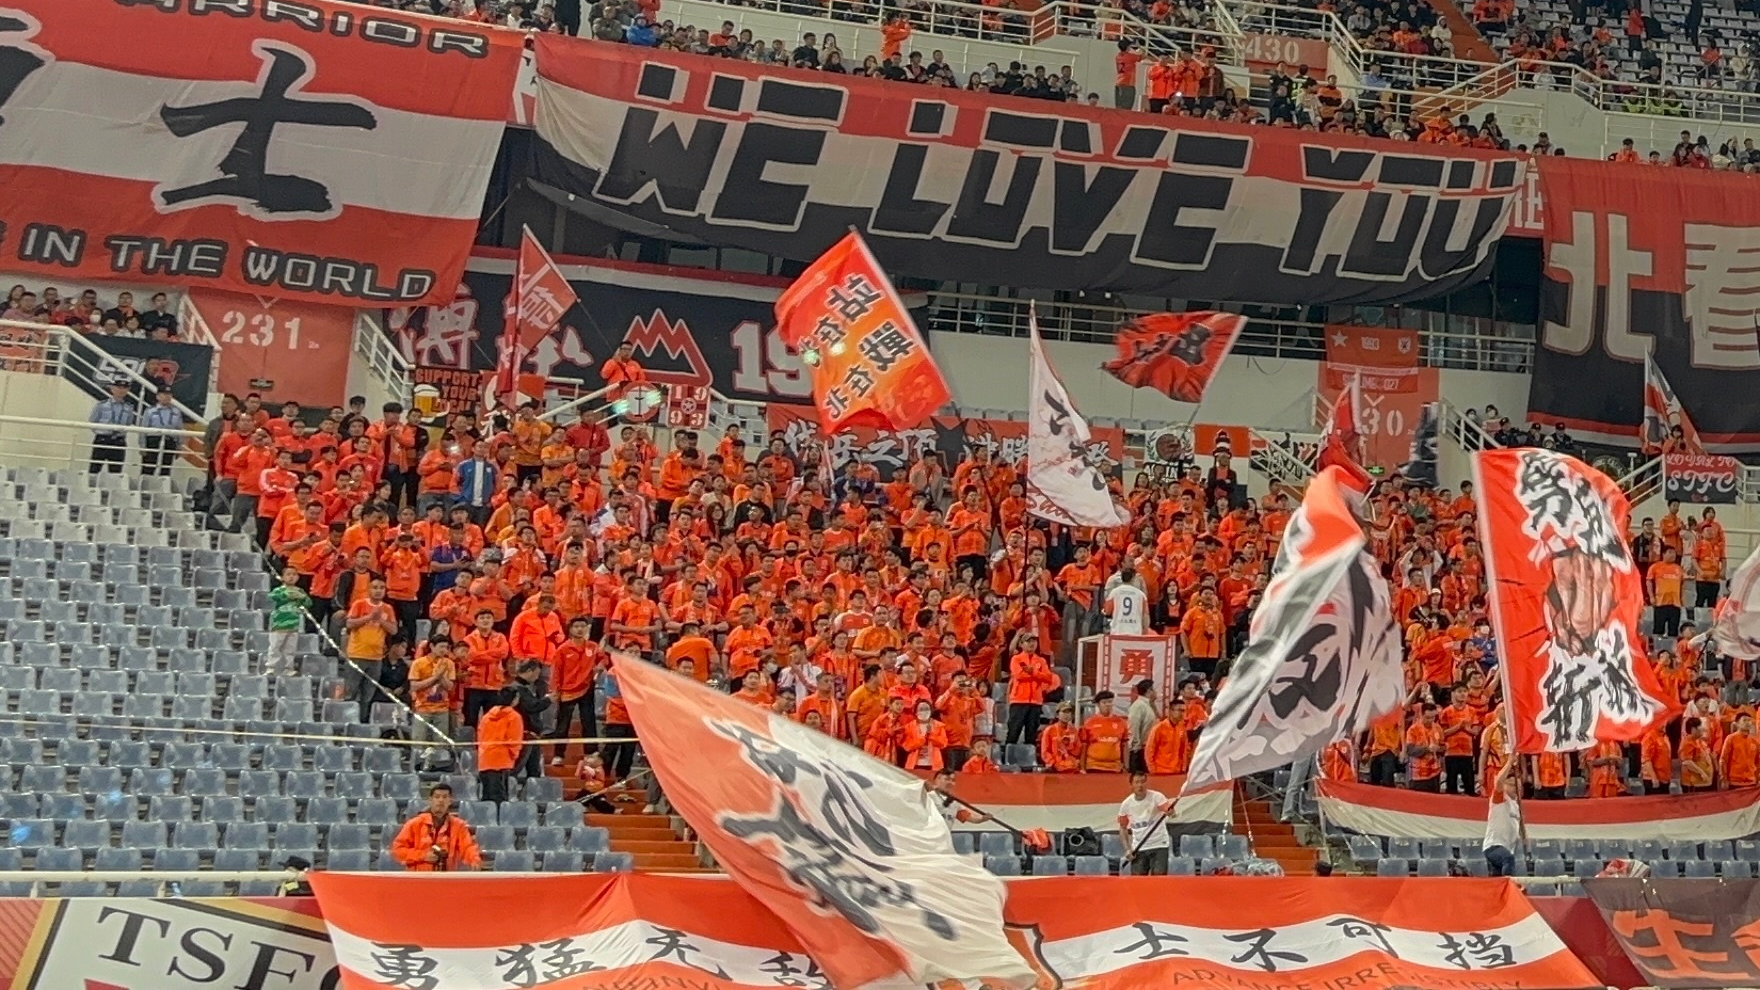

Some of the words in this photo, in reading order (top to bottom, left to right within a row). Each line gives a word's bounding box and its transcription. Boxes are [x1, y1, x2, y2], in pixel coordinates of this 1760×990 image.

[592, 60, 850, 231] WE
[867, 96, 1254, 272] LOVE
[1281, 143, 1523, 282] YOU
[24, 228, 83, 267] IN
[110, 236, 222, 277] THE
[246, 249, 437, 301] WORLD
[222, 310, 301, 350] 231
[730, 319, 813, 399] 19
[1361, 408, 1404, 437] 30
[1122, 596, 1133, 616] 9
[97, 903, 341, 990] TSF
